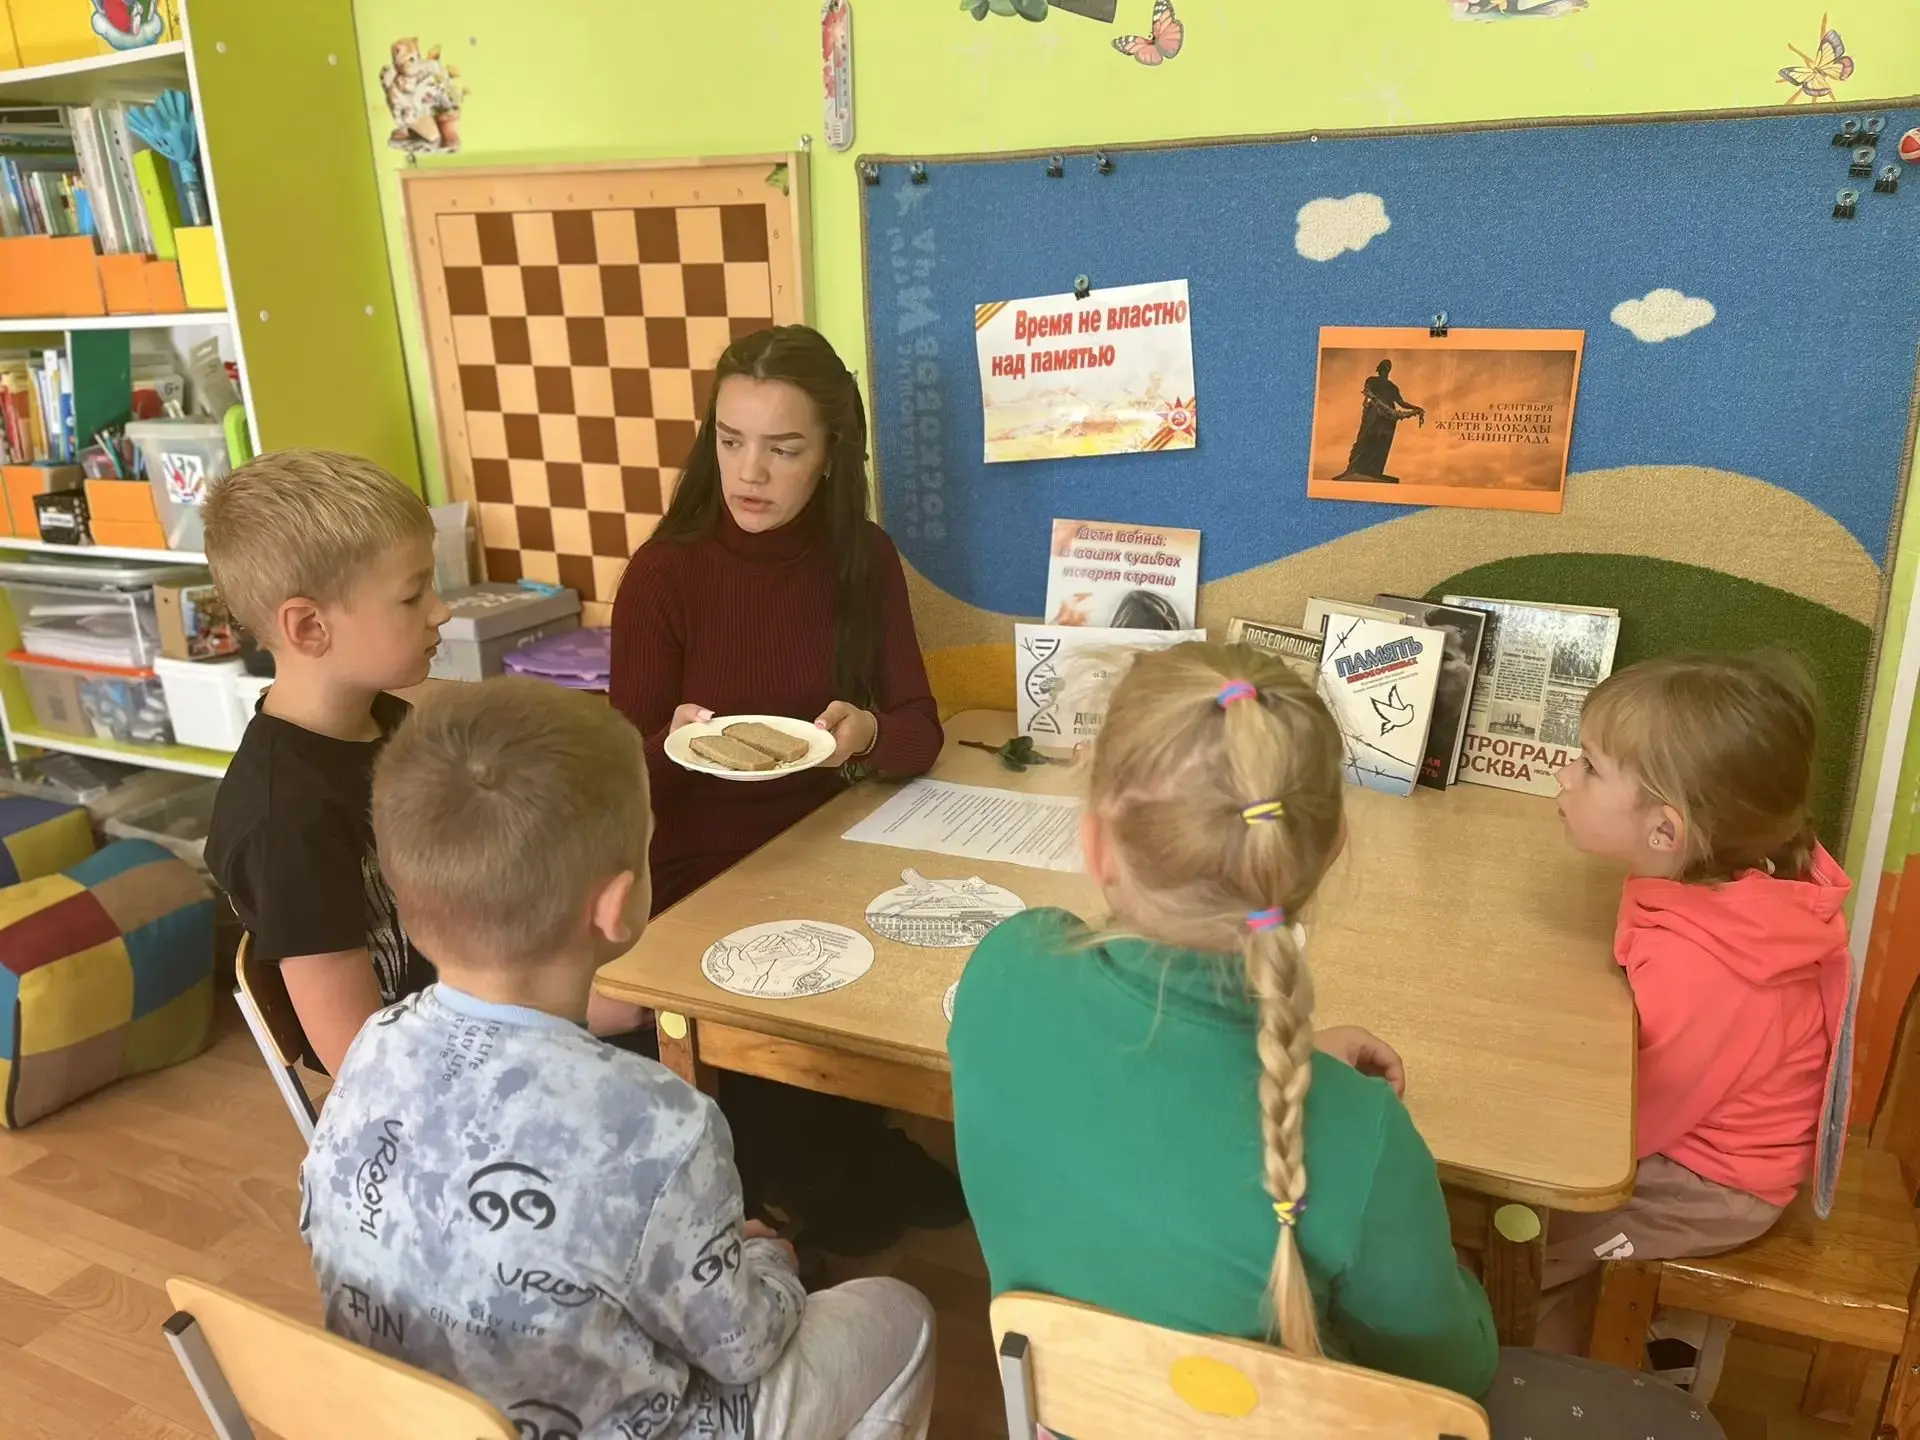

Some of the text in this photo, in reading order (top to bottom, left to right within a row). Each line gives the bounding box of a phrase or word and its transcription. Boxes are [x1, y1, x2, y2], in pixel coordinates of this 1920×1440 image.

[1015, 300, 1187, 346] Время не властно
[992, 344, 1116, 380] над памятью
[1451, 412, 1552, 423] ДЕНЬ ПАМЯТИ
[1497, 403, 1554, 412] СЕНТЯБРЯ
[1435, 420, 1552, 434] ЖЕРТВ БЛОКАДЫ
[1458, 432, 1551, 444] ЛЕНИНГРАДА
[1075, 526, 1168, 547] Дети войны:
[1074, 547, 1122, 562] ваших
[1124, 550, 1183, 568] судьбах
[1124, 568, 1177, 587] страны
[1246, 627, 1320, 660] ПОБЕДИВШИЕ
[1335, 635, 1424, 678] ПАМЯТЬ
[1466, 733, 1577, 769] ТРОГРАД-
[1459, 752, 1532, 782] ОСКВА
[342, 1283, 405, 1345] FUN
